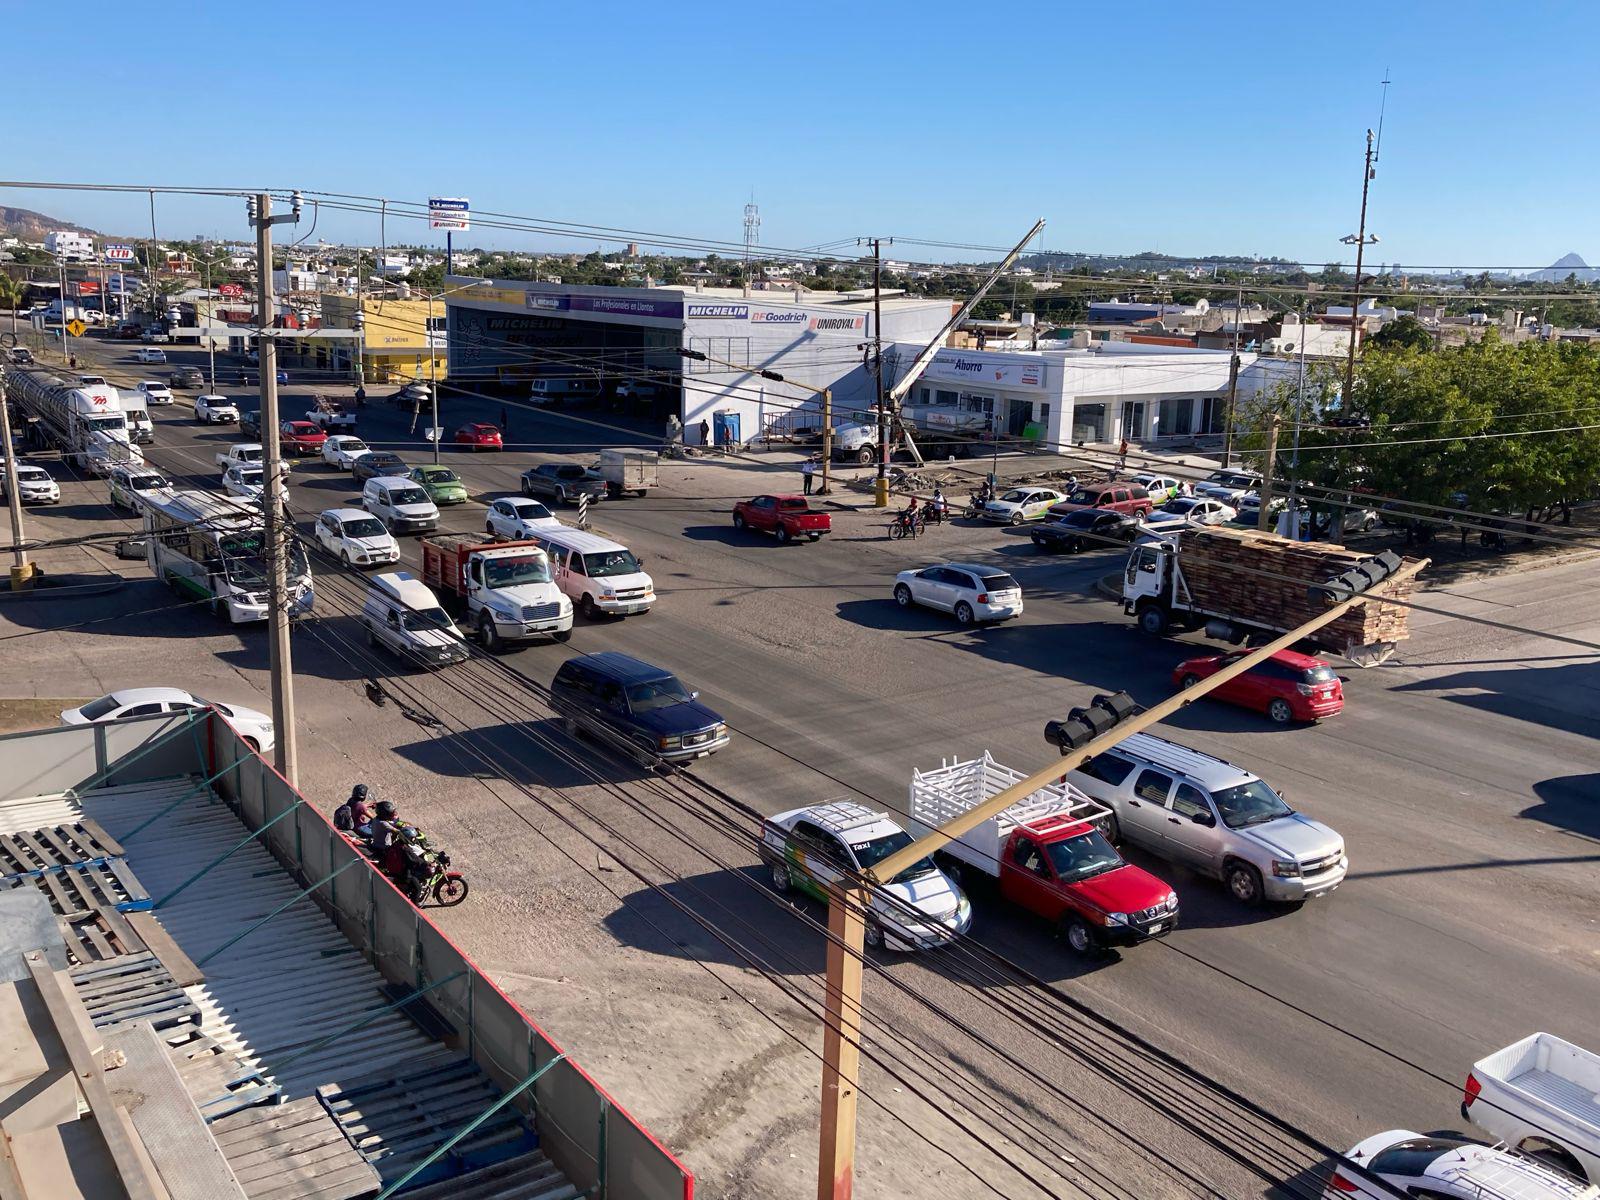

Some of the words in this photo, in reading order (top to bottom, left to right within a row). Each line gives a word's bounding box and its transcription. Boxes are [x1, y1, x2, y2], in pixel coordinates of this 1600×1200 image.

[111, 250, 129, 258] LTH
[601, 300, 630, 310] Profesionales
[637, 303, 655, 312] Llantas
[689, 306, 748, 317] MICHELIN
[752, 312, 807, 322] BFGoodrich
[489, 318, 564, 330] MICHELIN
[816, 317, 855, 330] UNIROYAL
[954, 358, 982, 372] Ahorro
